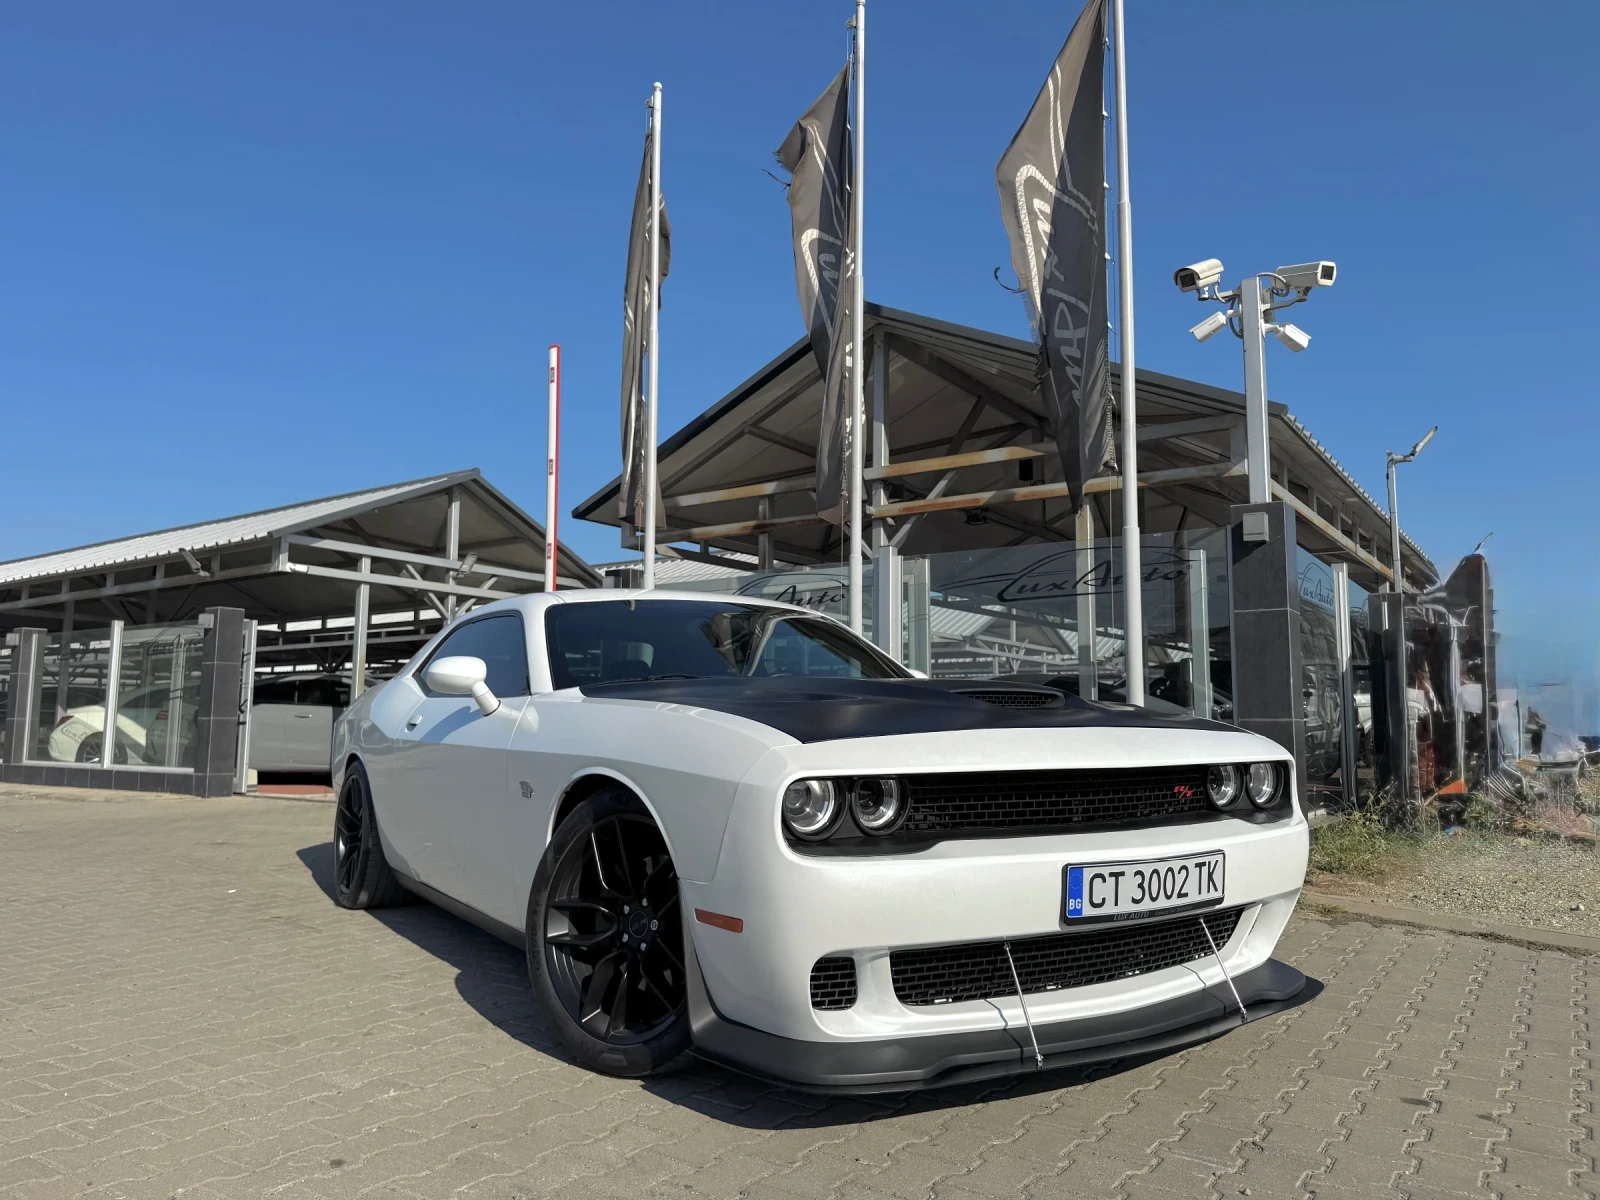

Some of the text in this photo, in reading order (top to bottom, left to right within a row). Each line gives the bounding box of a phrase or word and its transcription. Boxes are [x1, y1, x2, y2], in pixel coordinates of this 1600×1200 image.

[1088, 859, 1219, 909] CT 3002 TK
[1069, 898, 1082, 911] BG
[1113, 913, 1129, 921] LUX
[1129, 911, 1150, 919] AUTO
